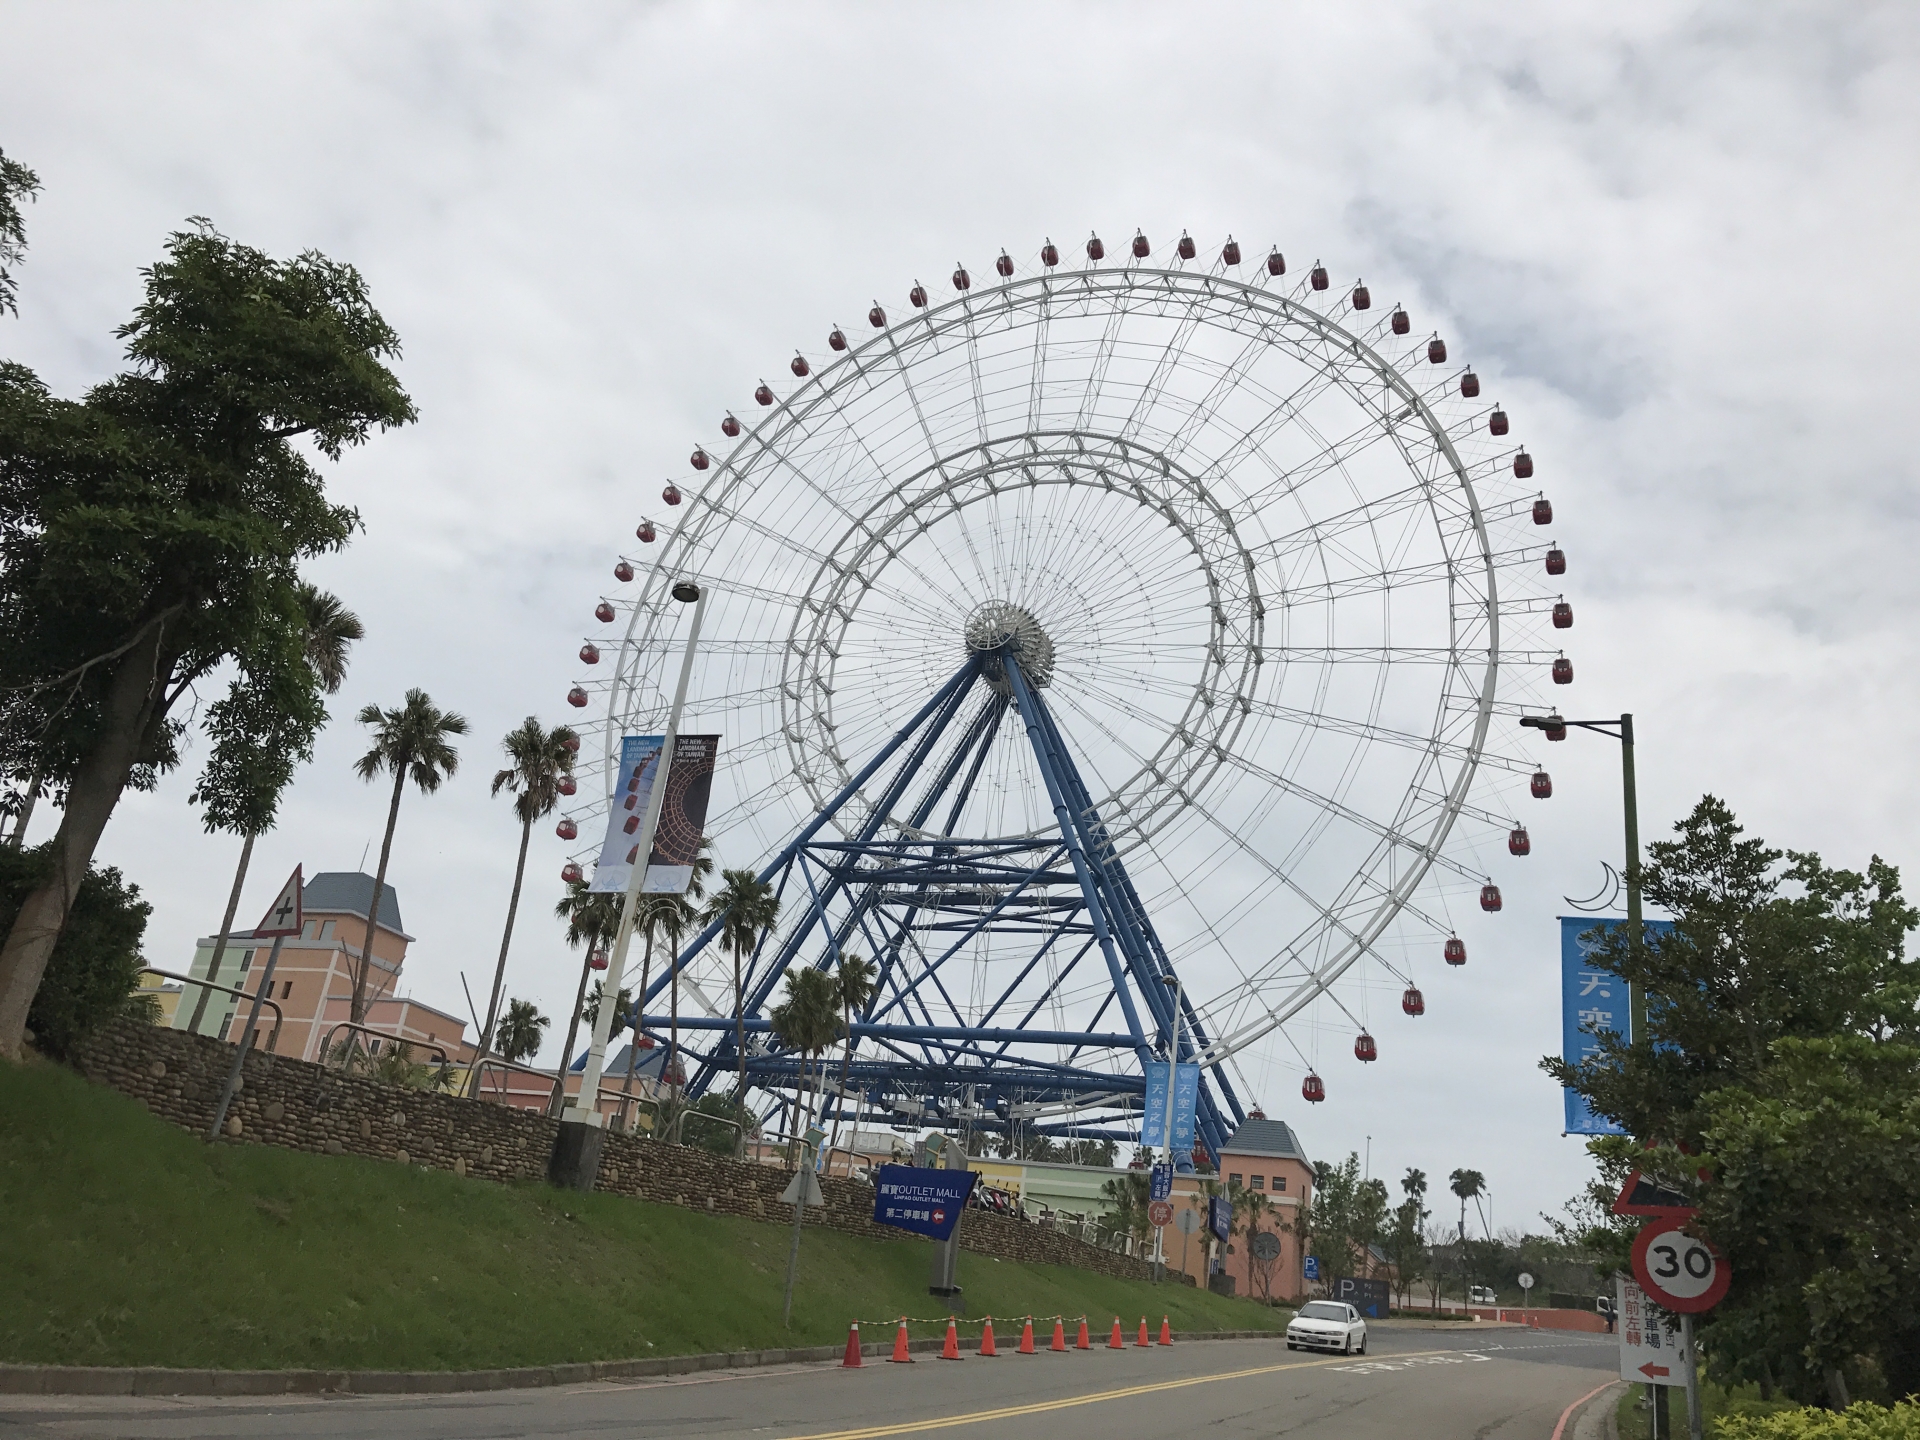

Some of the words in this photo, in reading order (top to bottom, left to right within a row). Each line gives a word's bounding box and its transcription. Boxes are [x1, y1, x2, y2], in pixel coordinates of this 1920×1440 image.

[1147, 1083, 1165, 1137] 天空之夢
[1175, 1084, 1192, 1139] 天空之夢
[936, 1188, 960, 1198] MALL
[886, 1208, 929, 1221] 第二停車場
[1153, 1206, 1168, 1222] 停
[1305, 1257, 1315, 1270] P
[1653, 1245, 1712, 1279] 30
[1340, 1279, 1355, 1298] P
